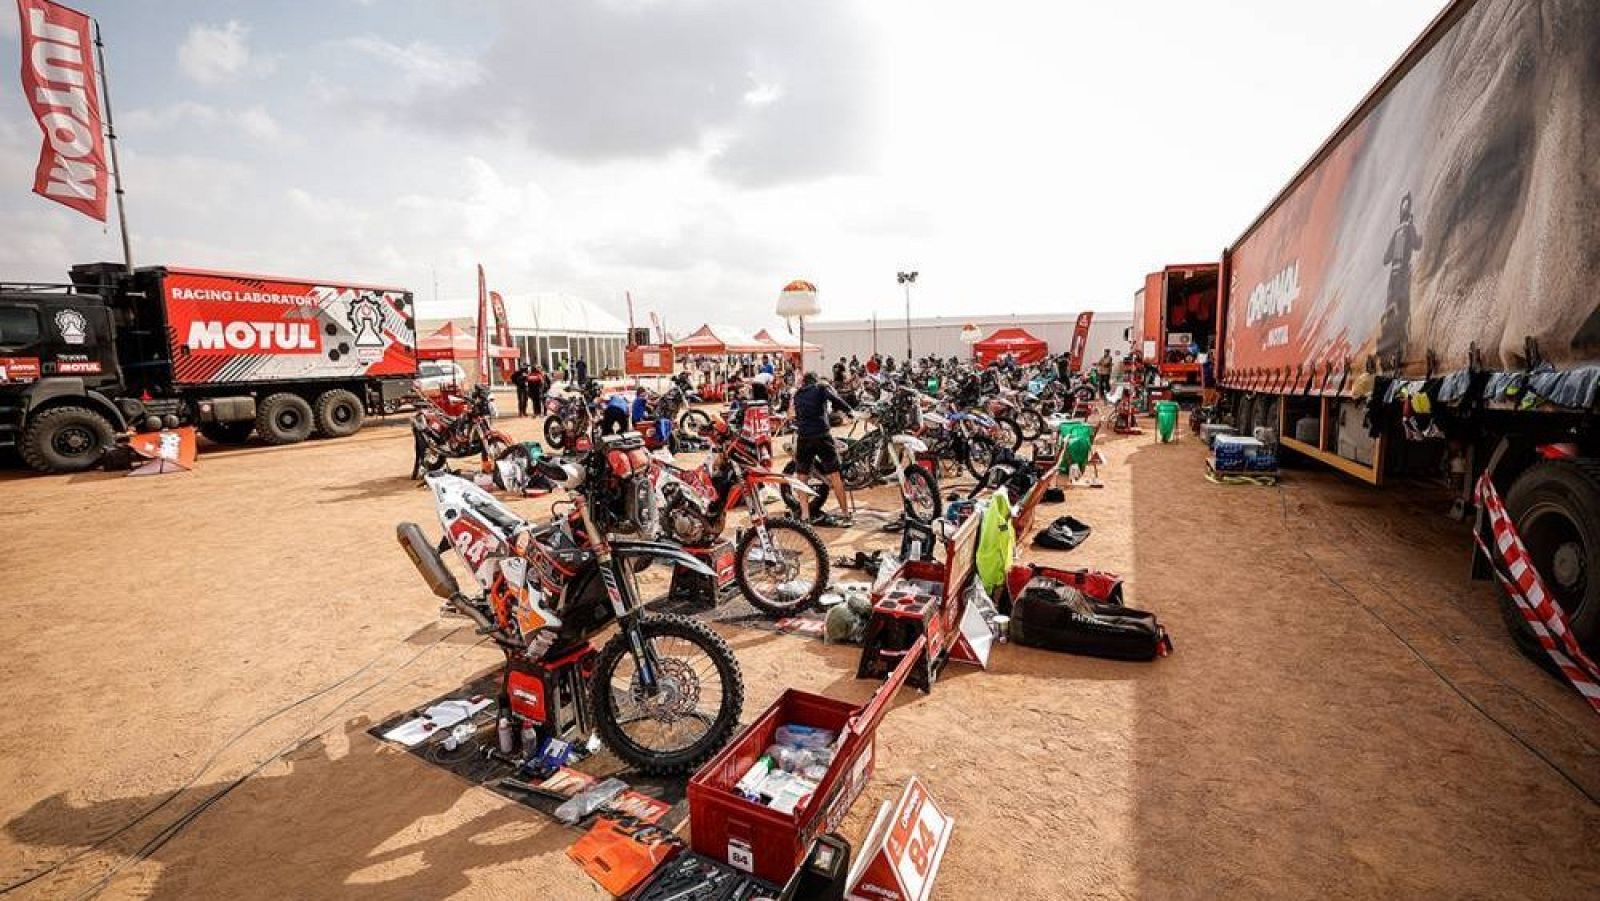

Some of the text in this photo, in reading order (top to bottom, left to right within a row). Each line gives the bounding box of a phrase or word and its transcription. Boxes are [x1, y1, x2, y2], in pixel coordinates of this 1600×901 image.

[172, 287, 318, 306] RACING LABORATORY
[188, 320, 316, 350] MOTUL
[59, 362, 102, 372] MOTUL
[733, 852, 748, 865] 84
[909, 820, 936, 878] 84
